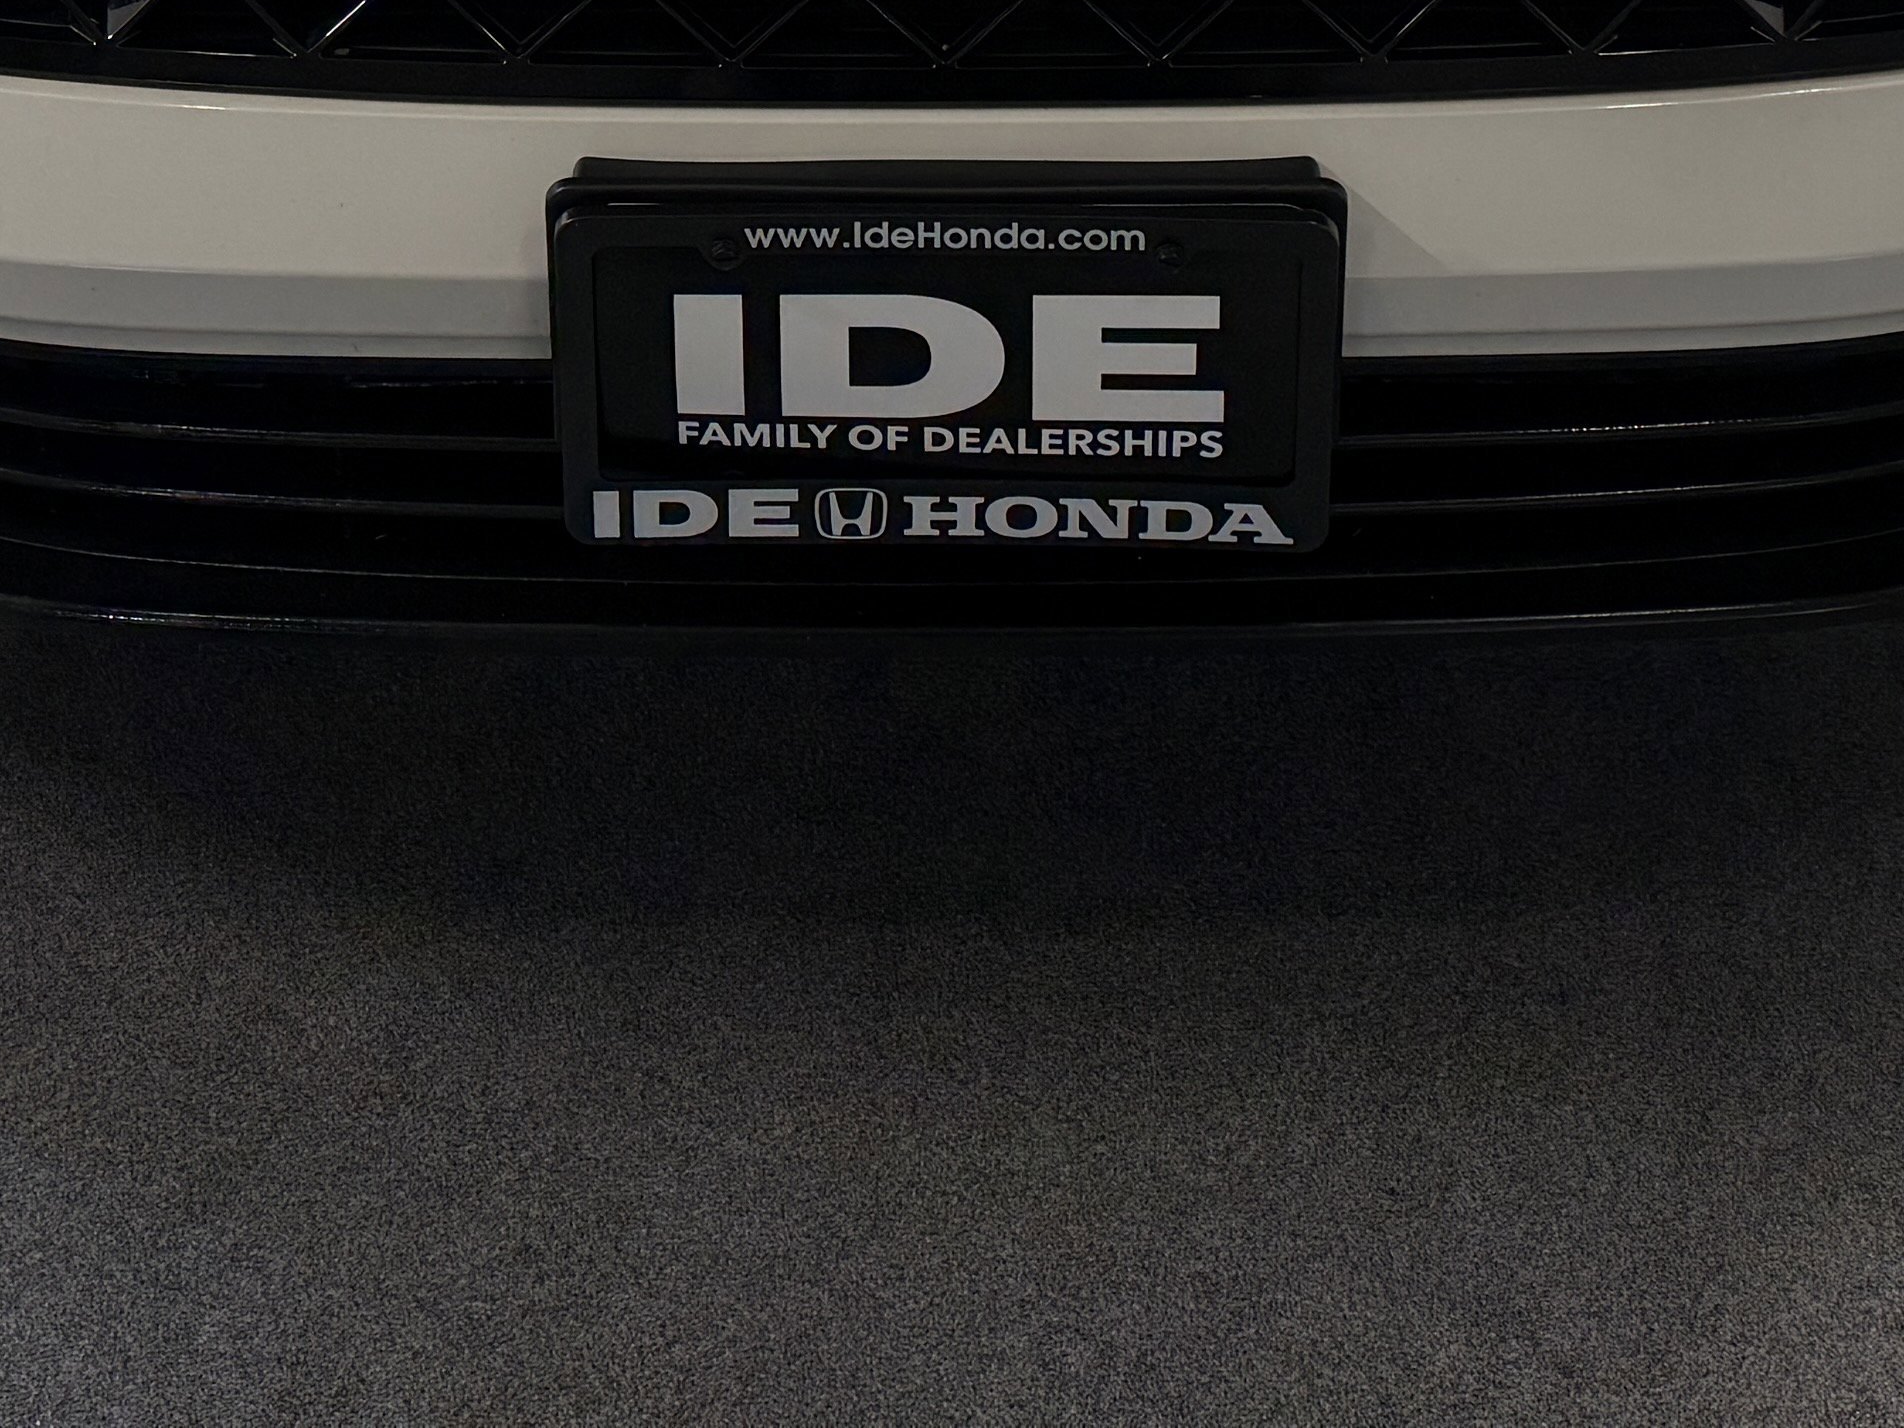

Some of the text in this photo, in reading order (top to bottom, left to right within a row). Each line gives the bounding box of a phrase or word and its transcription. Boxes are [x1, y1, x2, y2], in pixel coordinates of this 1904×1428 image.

[743, 220, 1146, 251] www.IdeHonda.com
[672, 293, 1226, 423] IDE
[677, 420, 1224, 458] FAMILY OF DEALERSHIPS
[592, 488, 800, 539] IDE
[903, 495, 1294, 545] HONDA
